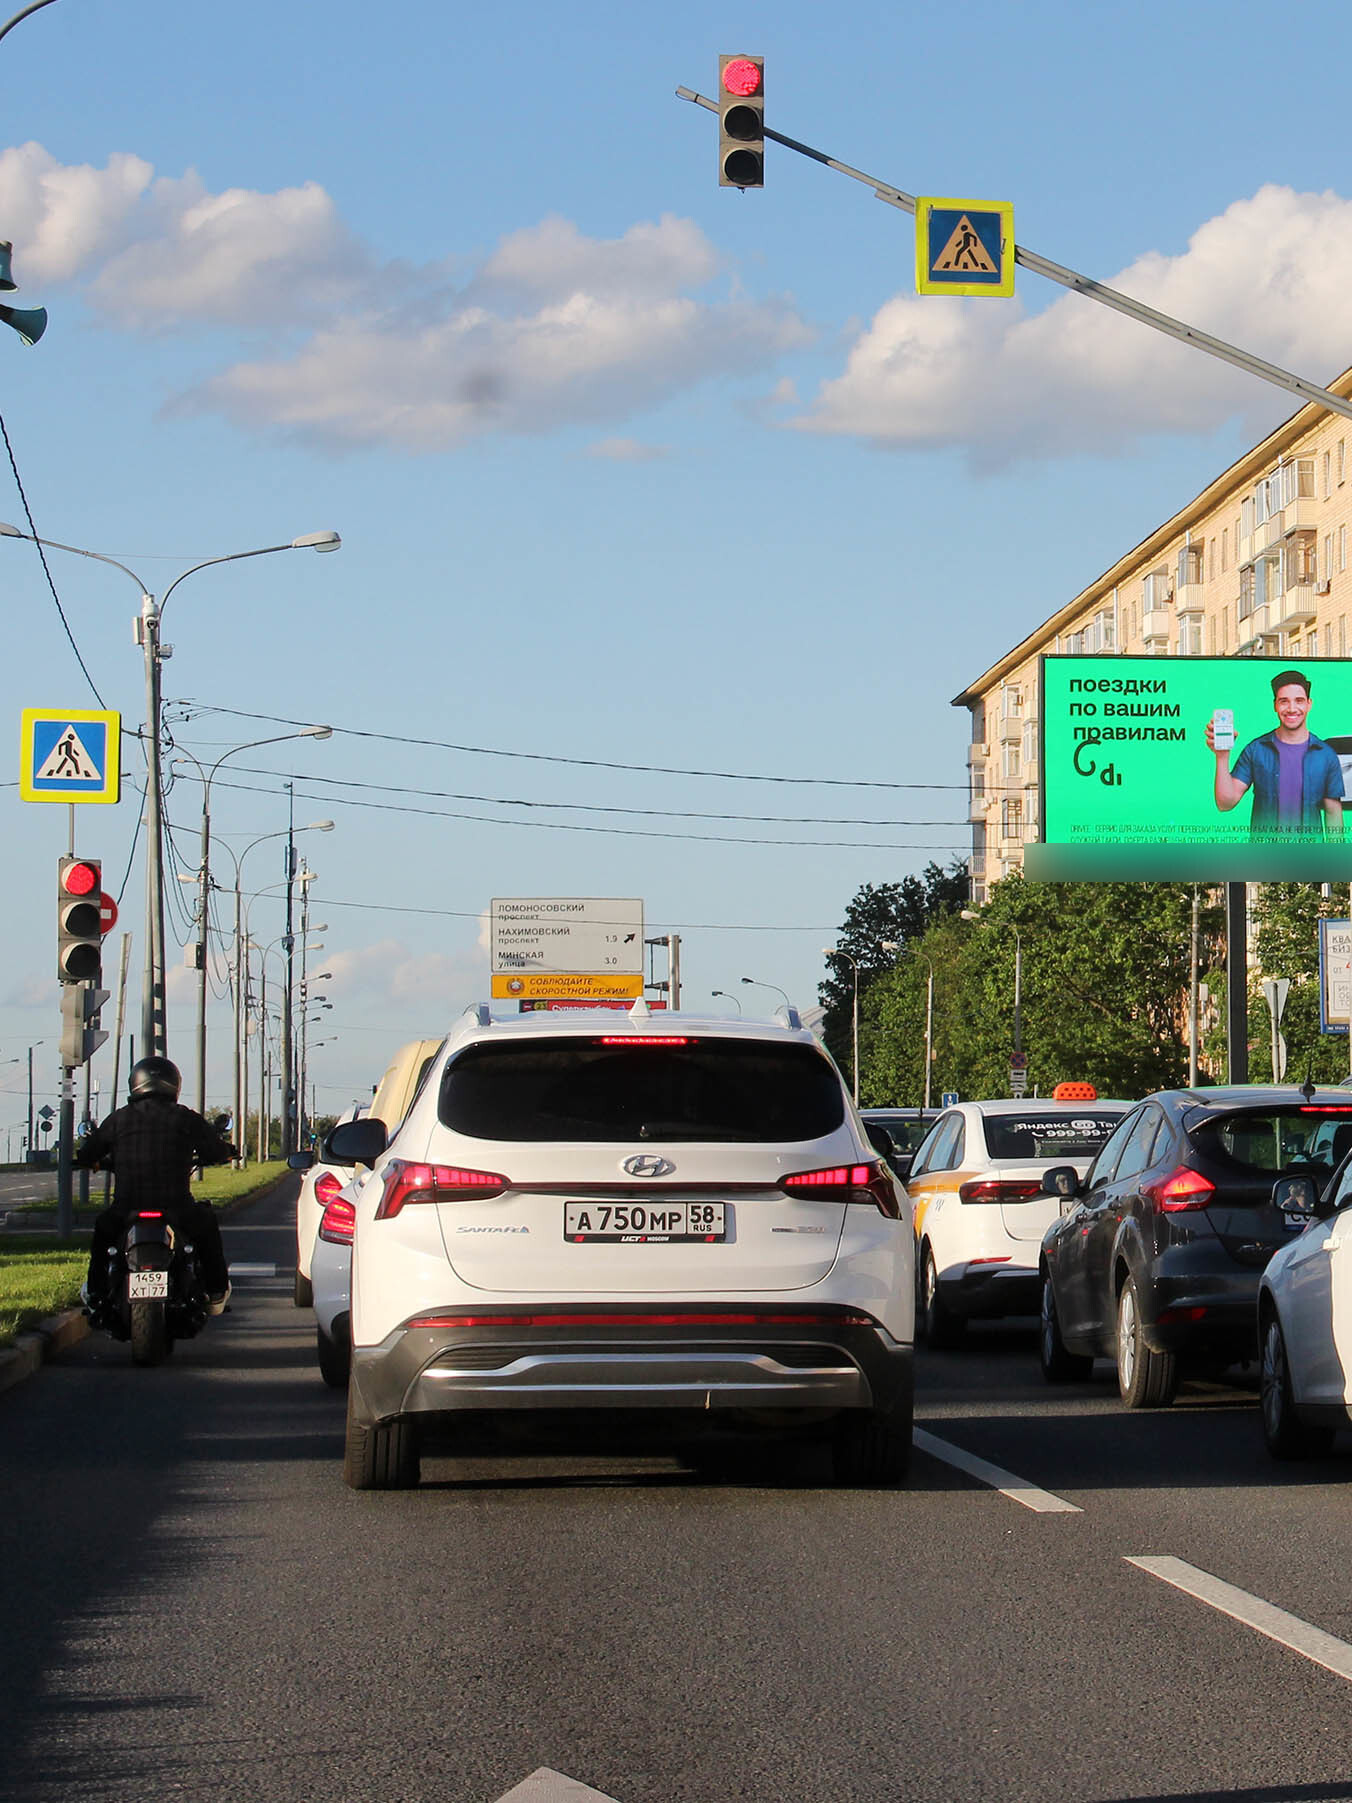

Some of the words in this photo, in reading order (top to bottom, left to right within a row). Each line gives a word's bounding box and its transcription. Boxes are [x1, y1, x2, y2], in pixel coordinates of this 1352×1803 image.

[1069, 679, 1167, 696] поездки
[1069, 703, 1097, 717] по
[1103, 703, 1181, 717] вашим
[1073, 727, 1186, 742] правилам
[498, 904, 585, 913] ЛОМОНОСОВСКИЙ
[498, 926, 571, 936] НАХИМОВСКИЙ
[498, 951, 544, 959] МИНСКАЯ
[498, 961, 526, 969] улица
[1017, 1122, 1069, 1130] Яндекс
[690, 1205, 715, 1224] 58
[693, 1224, 712, 1232] RUS
[135, 1273, 162, 1282] 1459
[152, 1286, 166, 1296] 77
